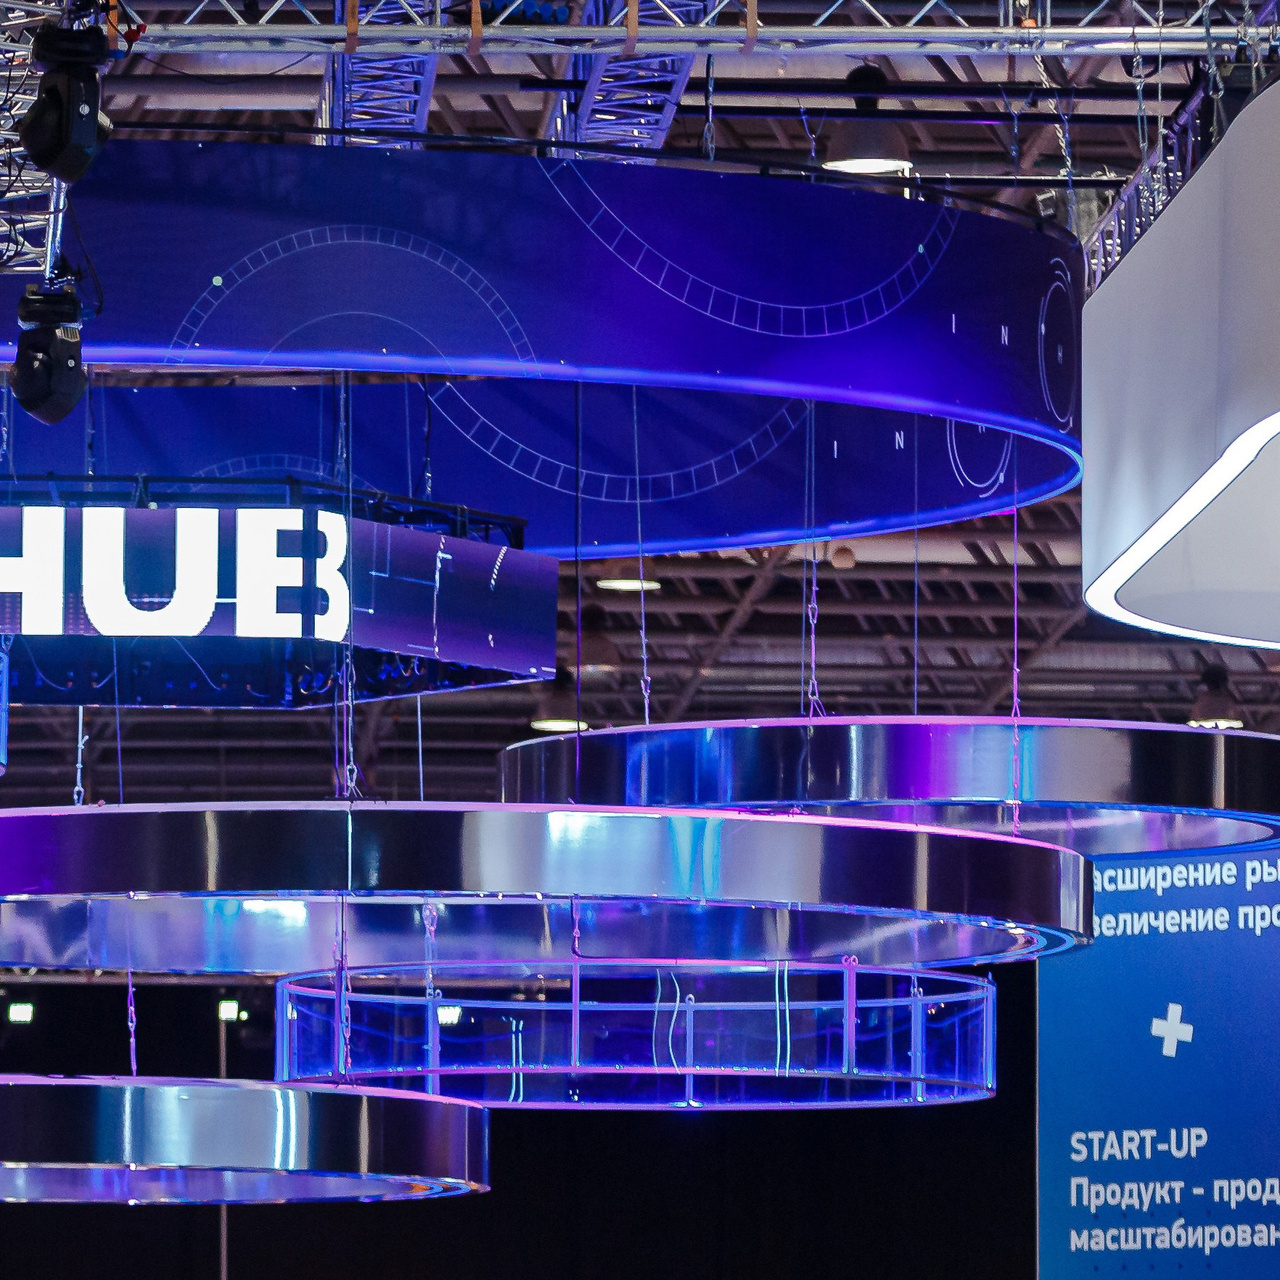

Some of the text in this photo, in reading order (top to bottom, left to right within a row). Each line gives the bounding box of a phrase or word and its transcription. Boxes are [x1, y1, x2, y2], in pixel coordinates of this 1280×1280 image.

[1093, 859, 1237, 897] асширение
[1070, 1127, 1209, 1163] START-UP
[1070, 1176, 1186, 1214] Продукт
[1213, 1177, 1280, 1210] прод
